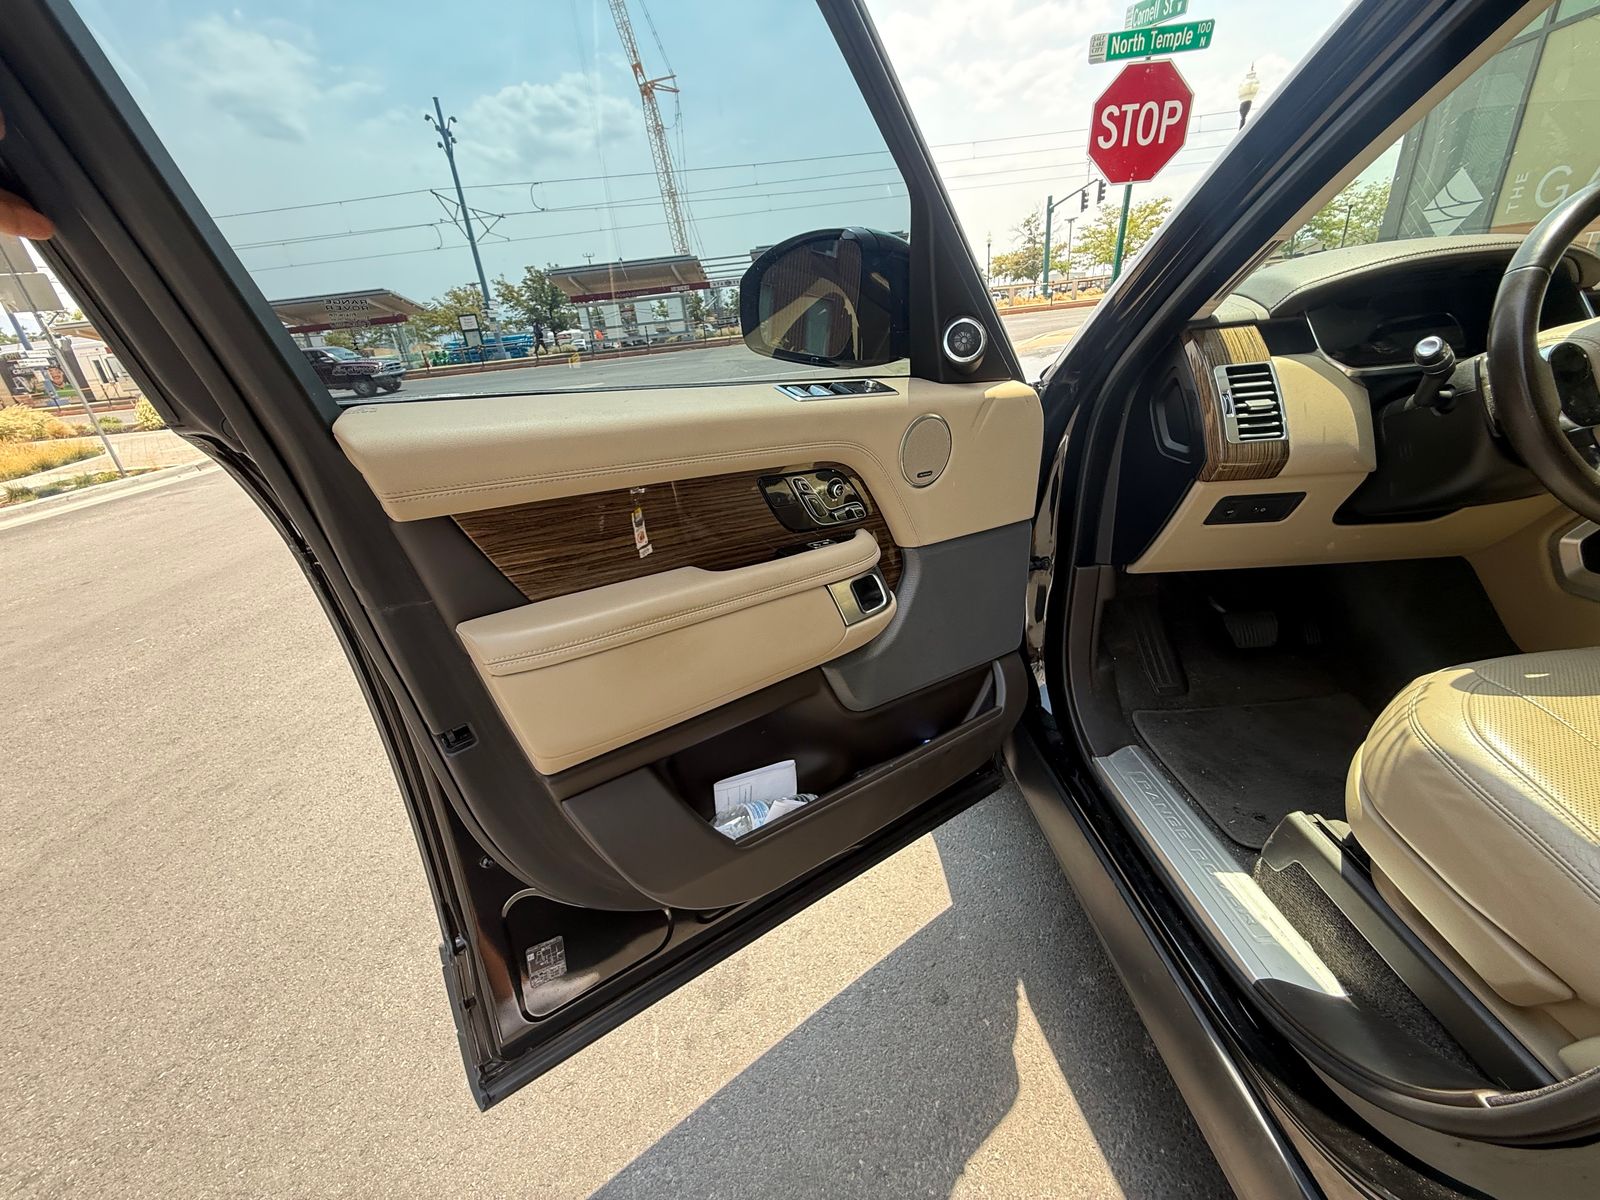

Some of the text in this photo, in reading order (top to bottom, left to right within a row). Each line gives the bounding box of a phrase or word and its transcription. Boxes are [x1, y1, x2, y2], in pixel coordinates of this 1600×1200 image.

[1132, 0, 1160, 26] Cornell
[1163, 0, 1174, 16] St
[1110, 26, 1193, 55] North Temple
[1197, 22, 1212, 35] 100
[1199, 36, 1207, 47] N
[1097, 100, 1183, 150] STOP
[1505, 171, 1530, 214] THE
